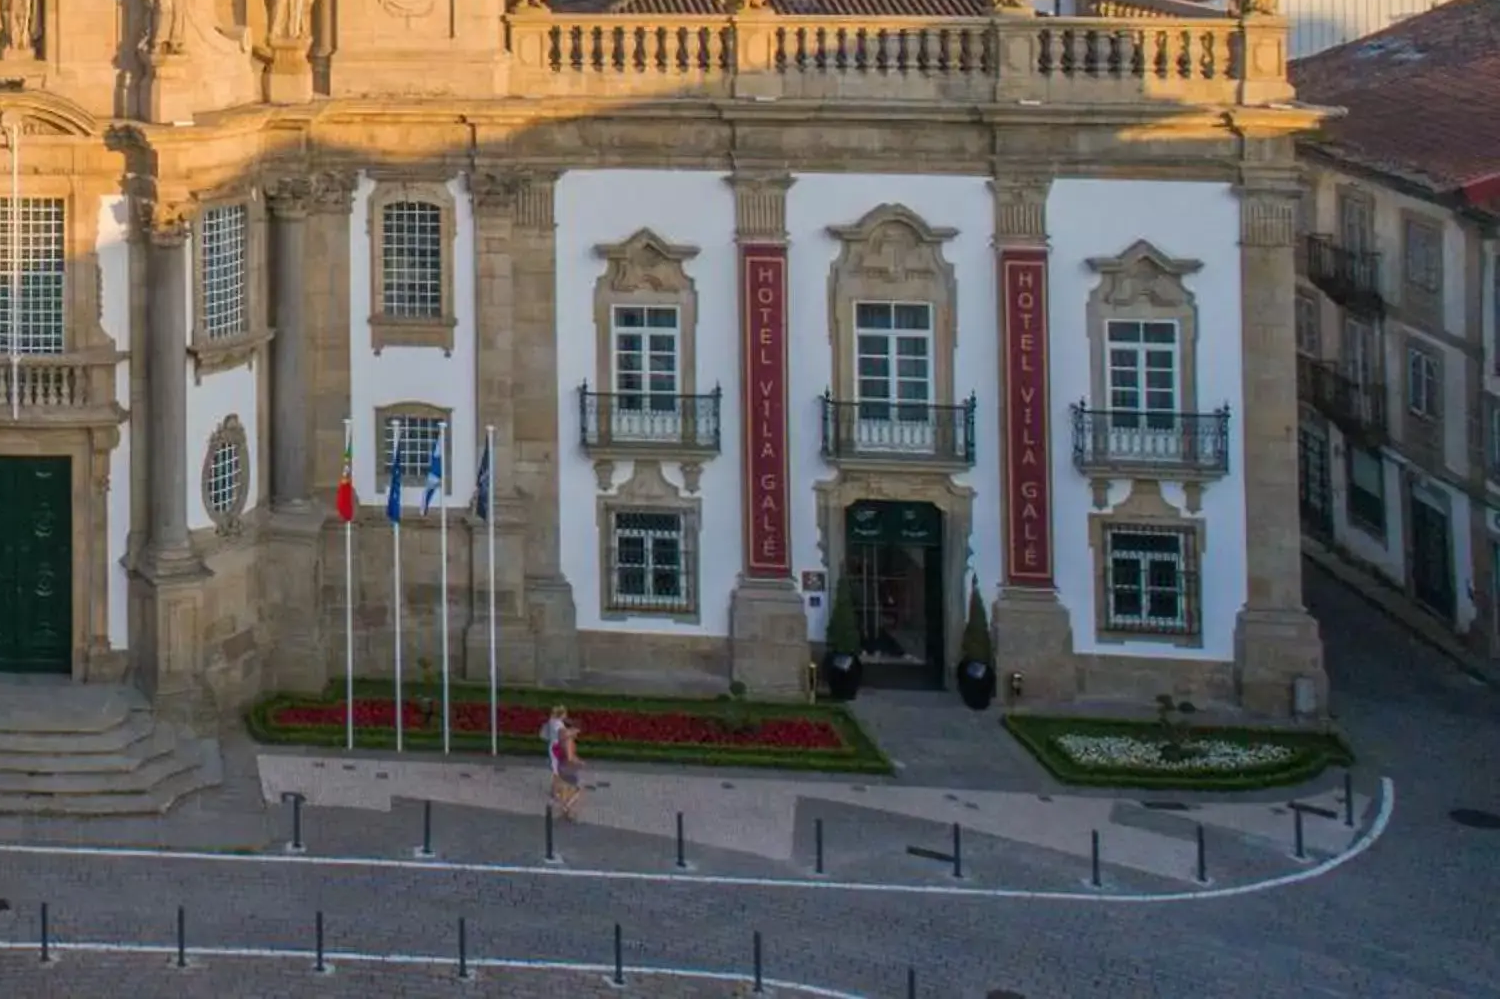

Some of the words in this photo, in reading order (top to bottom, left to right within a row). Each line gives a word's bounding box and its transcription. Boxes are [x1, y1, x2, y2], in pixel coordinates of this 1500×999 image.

[758, 267, 772, 364] HOTEL
[1018, 272, 1033, 371] HOTEL
[760, 380, 775, 457] VILA
[1021, 386, 1035, 464] VILA
[761, 475, 776, 557] GALÉ
[1021, 481, 1037, 566] GALÉ
